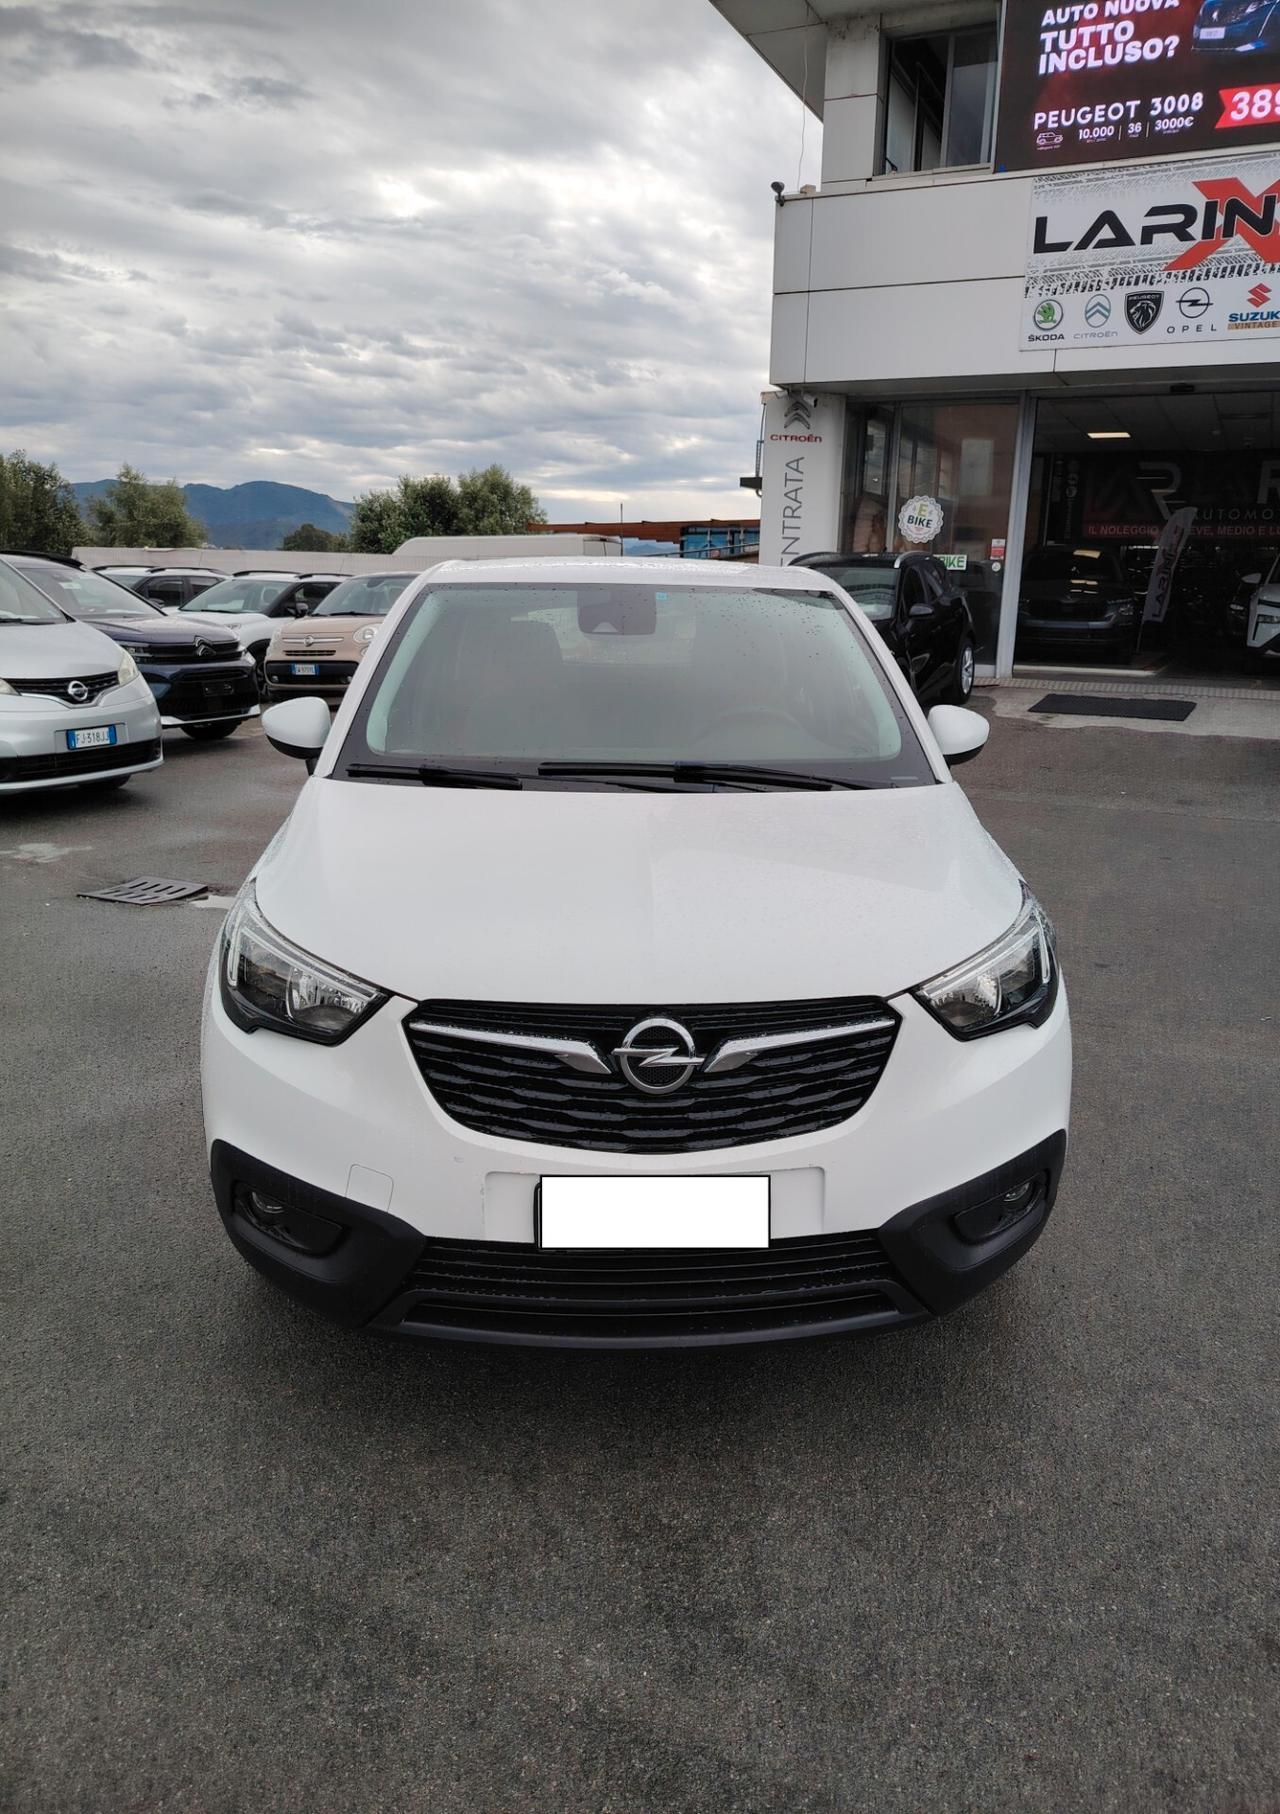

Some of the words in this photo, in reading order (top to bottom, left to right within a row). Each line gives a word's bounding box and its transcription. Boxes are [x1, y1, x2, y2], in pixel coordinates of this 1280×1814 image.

[1041, 3, 1099, 27] AUTO
[1040, 20, 1135, 52] TUTTO
[1039, 35, 1180, 75] INCLUSO?
[1033, 100, 1141, 130] PEUGEOT
[1150, 92, 1203, 116] 3008
[1231, 88, 1280, 120] 38
[1127, 123, 1142, 135] 36
[1155, 116, 1194, 131] 3000€
[1078, 125, 1114, 140] 10.000
[1166, 323, 1217, 334] OPEL
[1027, 333, 1065, 342] ŠKODA
[907, 514, 933, 529] BIKE
[1100, 525, 1159, 536] NOLEGGIO
[1217, 525, 1256, 537] MEDIO
